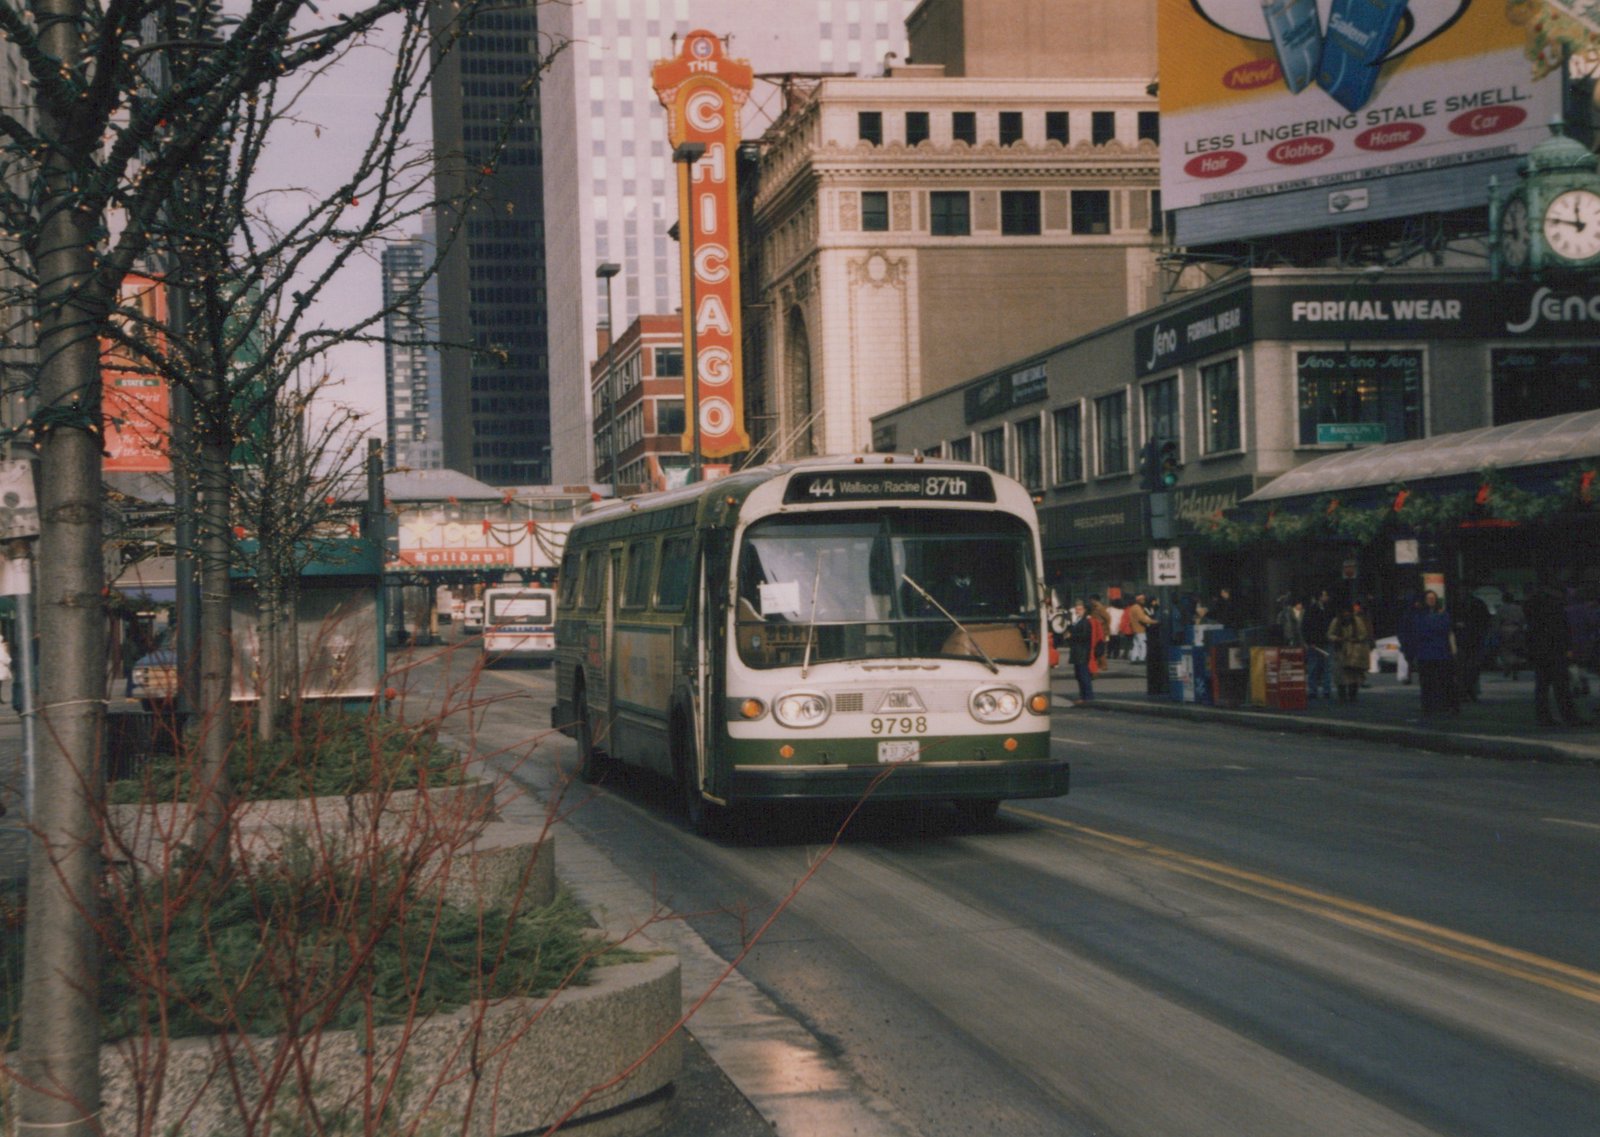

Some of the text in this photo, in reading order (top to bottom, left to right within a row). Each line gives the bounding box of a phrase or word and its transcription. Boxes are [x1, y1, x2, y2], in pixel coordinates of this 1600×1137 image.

[687, 60, 718, 74] THE
[1230, 63, 1277, 87] New!
[1184, 85, 1532, 155] LESS LINGERING STALE SMELL.
[1470, 114, 1499, 131] Car
[1369, 129, 1412, 147] Home
[1275, 141, 1325, 161] Clothes
[1201, 156, 1230, 173] Hair
[686, 90, 734, 438] CHICAGO
[1292, 299, 1461, 321] FORMAL WEAR
[1187, 317, 1218, 343] FORMAL
[1217, 308, 1241, 333] WEAR
[808, 477, 836, 497] 44
[925, 476, 967, 496] 87th
[1156, 551, 1176, 561] ONE
[1158, 561, 1177, 571] WAY
[889, 691, 913, 708] GMC
[870, 715, 928, 735] 9798
